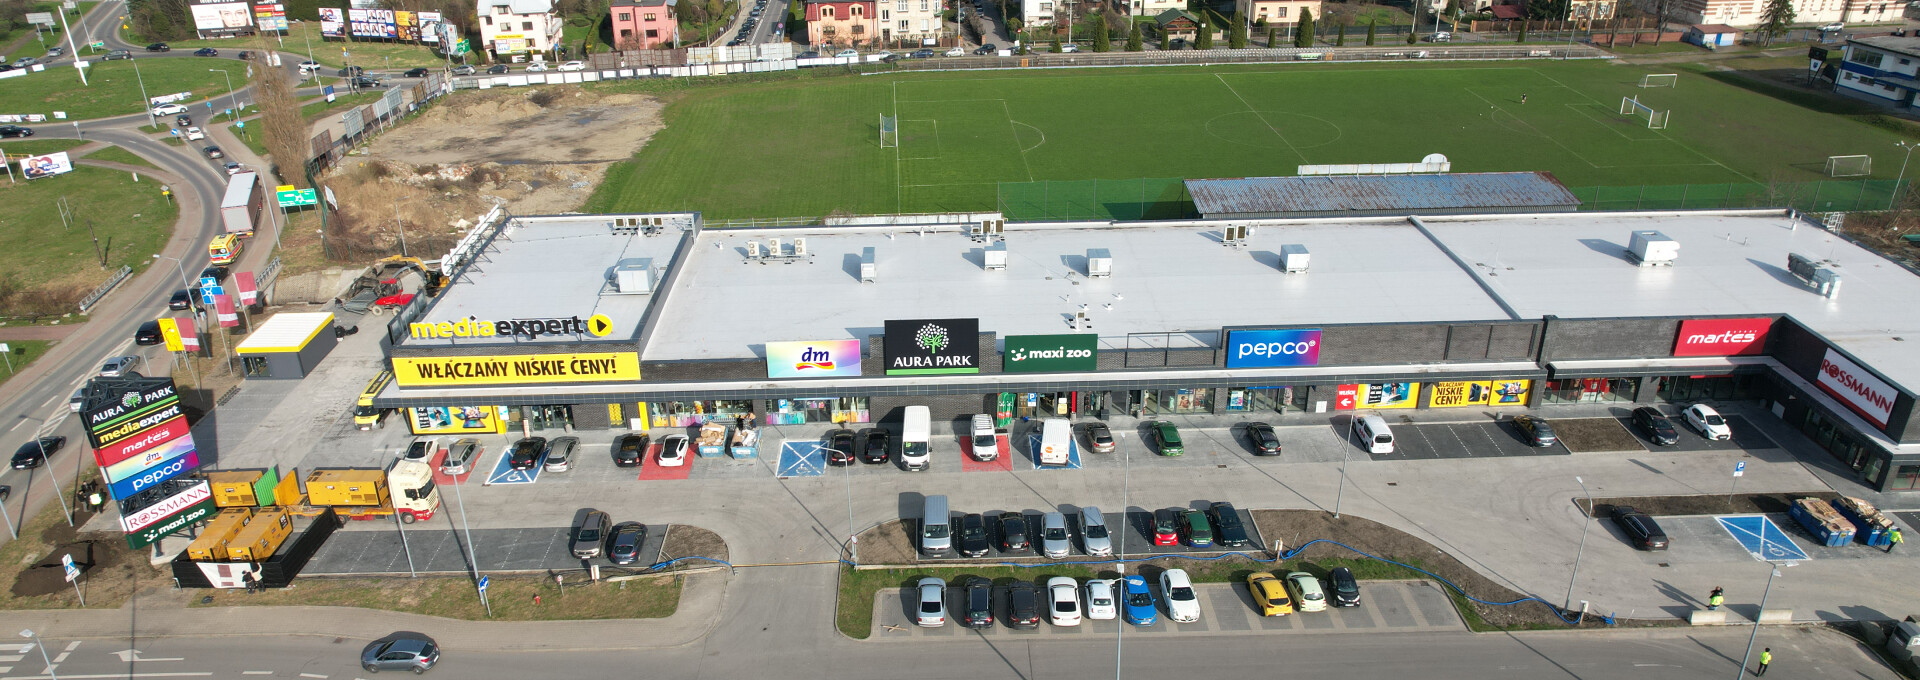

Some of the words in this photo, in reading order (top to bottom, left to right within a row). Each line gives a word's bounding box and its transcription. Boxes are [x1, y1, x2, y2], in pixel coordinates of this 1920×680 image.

[409, 315, 584, 339] mediaexpert
[1686, 330, 1756, 344] martes
[801, 346, 830, 362] dm
[1029, 346, 1064, 359] maxi
[1066, 349, 1092, 358] zoo
[1238, 341, 1309, 359] pepco
[416, 361, 508, 380] WŁĄCZAMY
[513, 360, 566, 377] NISKIE
[570, 358, 617, 375] CENY!
[893, 356, 933, 368] AURA
[936, 355, 972, 367] PARK
[1436, 387, 1464, 395] NISKIE
[1821, 359, 1892, 413] ROSSMANN
[92, 405, 125, 424] AURA
[144, 385, 174, 403] PARK
[1435, 396, 1463, 405] CENY!
[99, 405, 180, 443] mediaexpert
[122, 430, 170, 455] martes
[146, 452, 160, 462] dm
[132, 462, 182, 491] pepco
[128, 486, 209, 529] ROSSMANN
[158, 514, 186, 535] maxi
[186, 508, 206, 521] zoo
